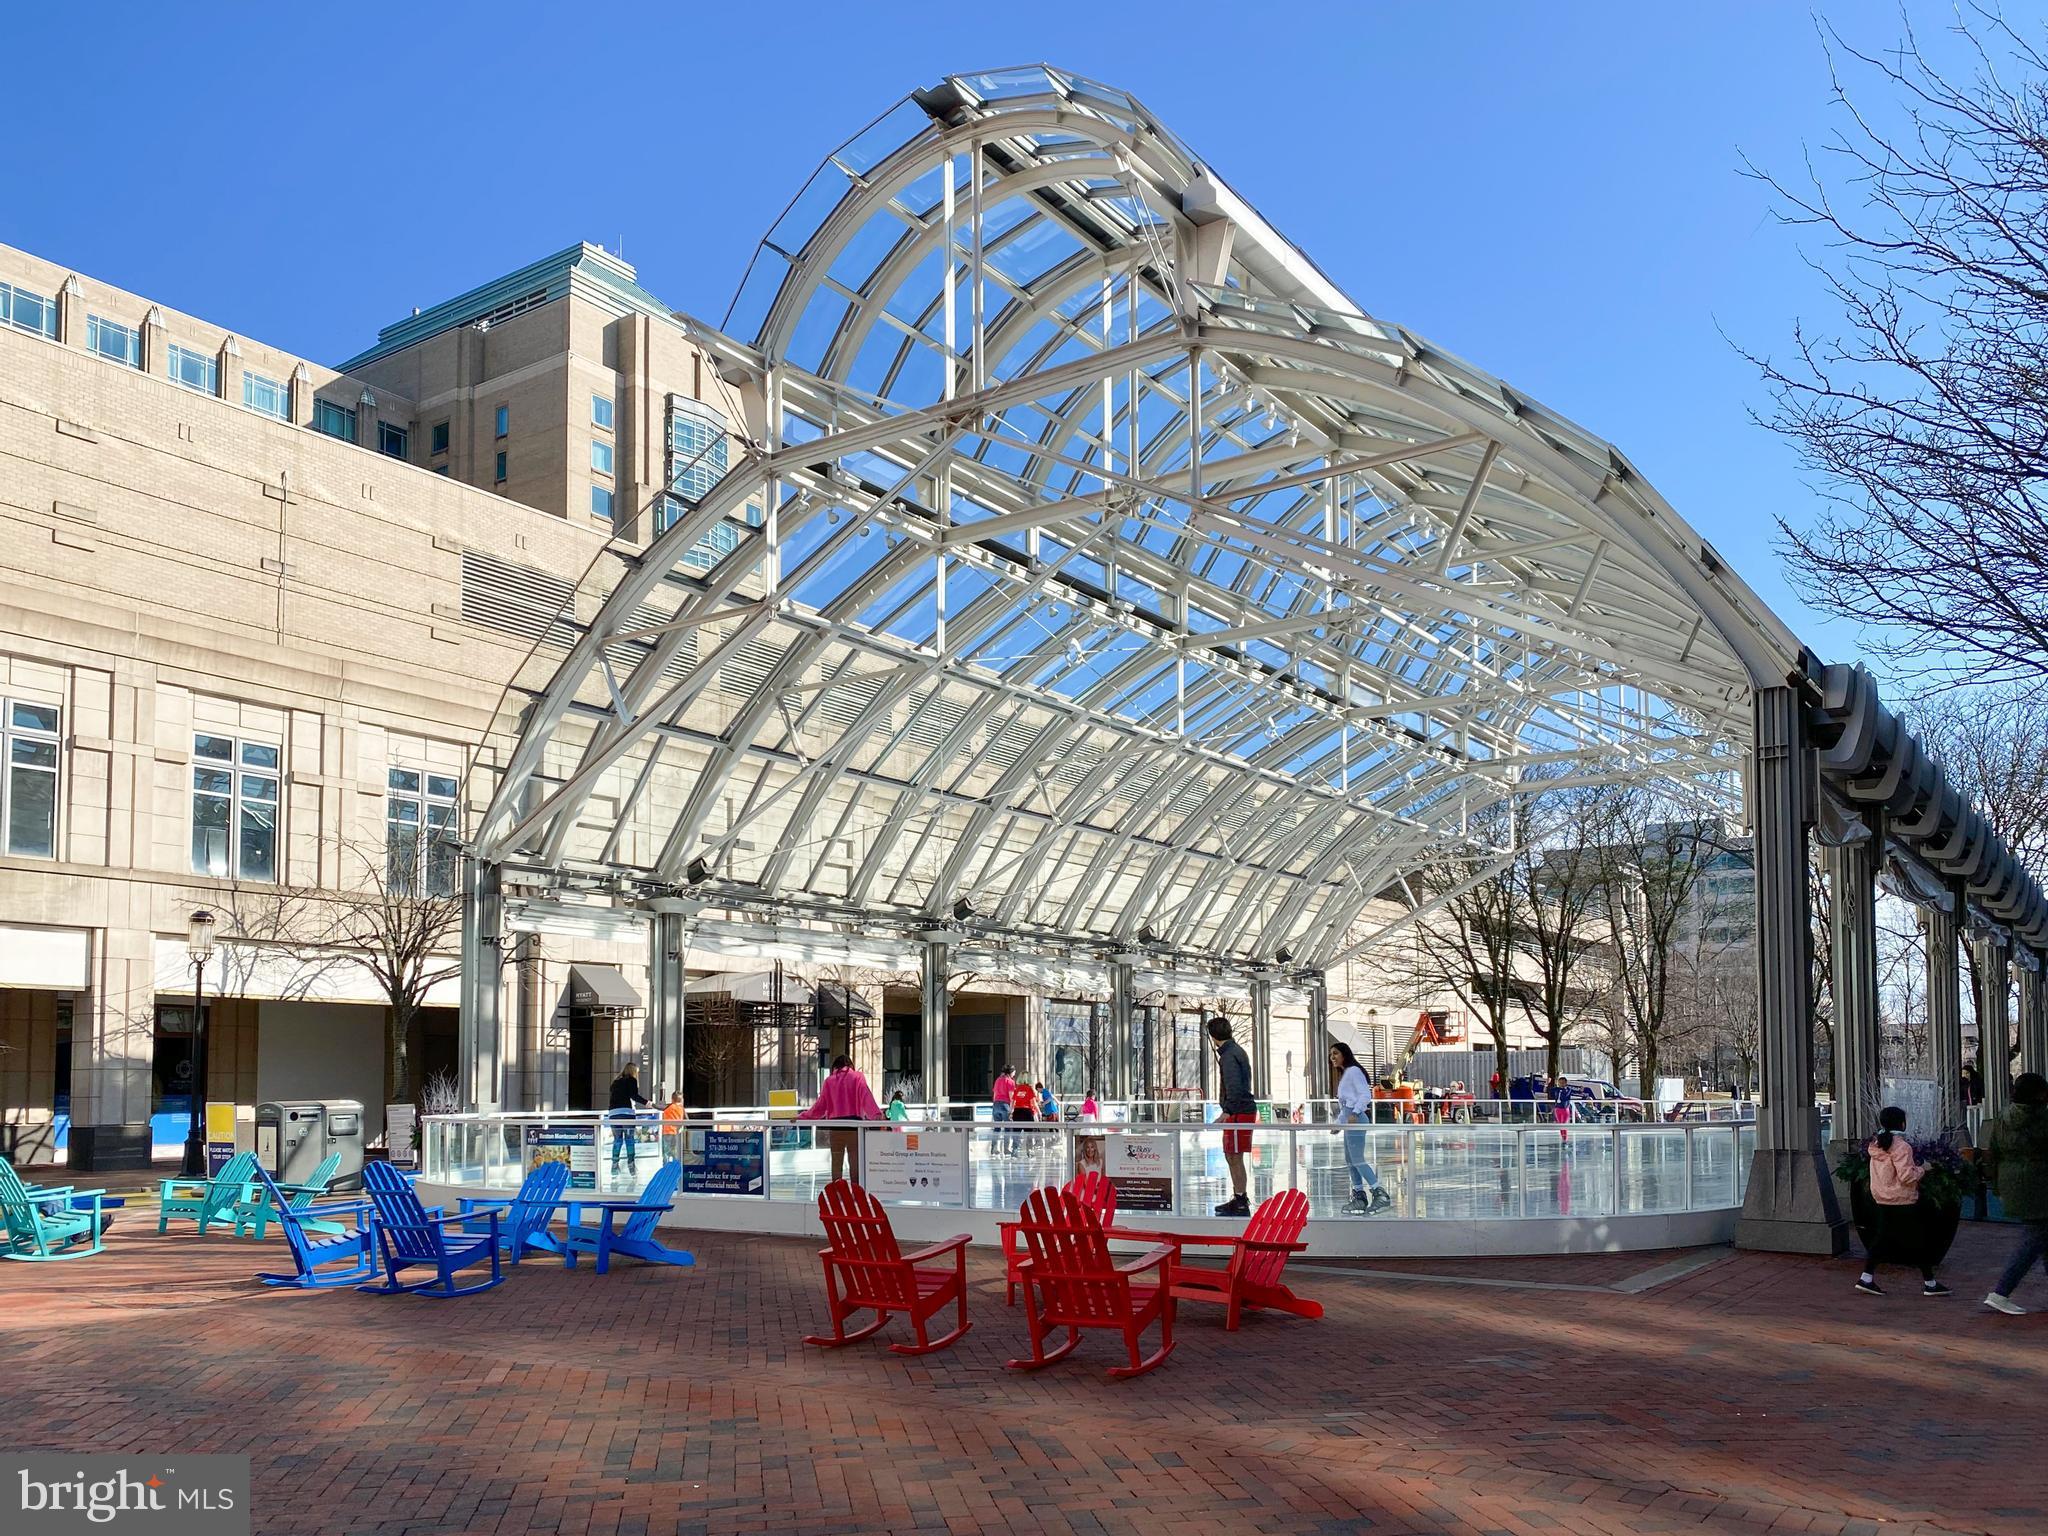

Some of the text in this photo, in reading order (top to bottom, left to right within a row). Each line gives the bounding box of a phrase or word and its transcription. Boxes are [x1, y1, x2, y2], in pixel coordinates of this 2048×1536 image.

[208, 1131, 235, 1140] CAUTION
[745, 1136, 760, 1145] Group
[1136, 1145, 1152, 1153] Busy
[688, 1171, 742, 1181] Trusted advice for your
[688, 1181, 704, 1190] unique
[705, 1180, 725, 1189] financial
